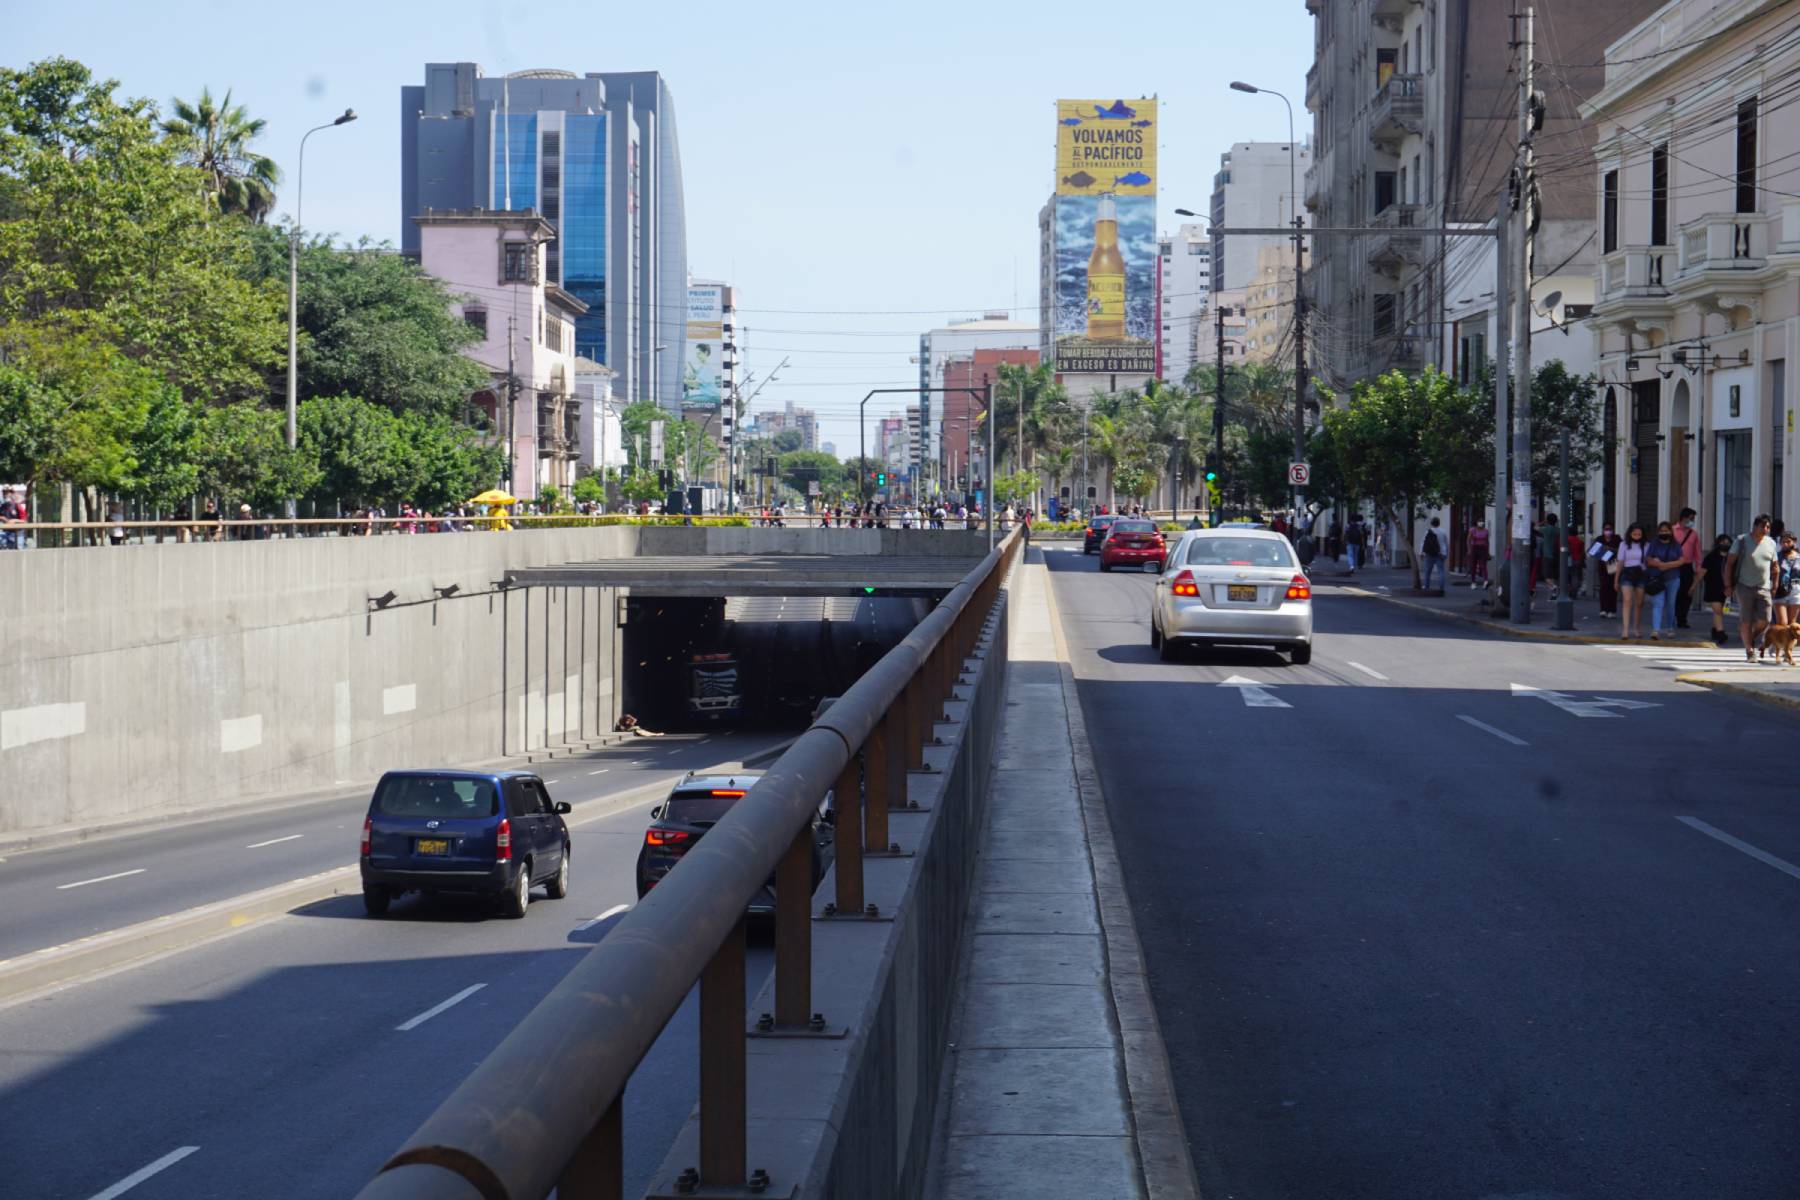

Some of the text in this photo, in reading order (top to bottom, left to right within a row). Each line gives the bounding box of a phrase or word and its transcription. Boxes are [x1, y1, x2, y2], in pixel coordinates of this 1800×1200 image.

[1072, 129, 1143, 144] VOLVAMOS
[1084, 145, 1143, 160] PACÍFICO
[1059, 348, 1081, 358] TOMAR
[1082, 348, 1109, 358] BEBIDAS
[1058, 358, 1153, 370] EN EXCESO ES DAÑINO
